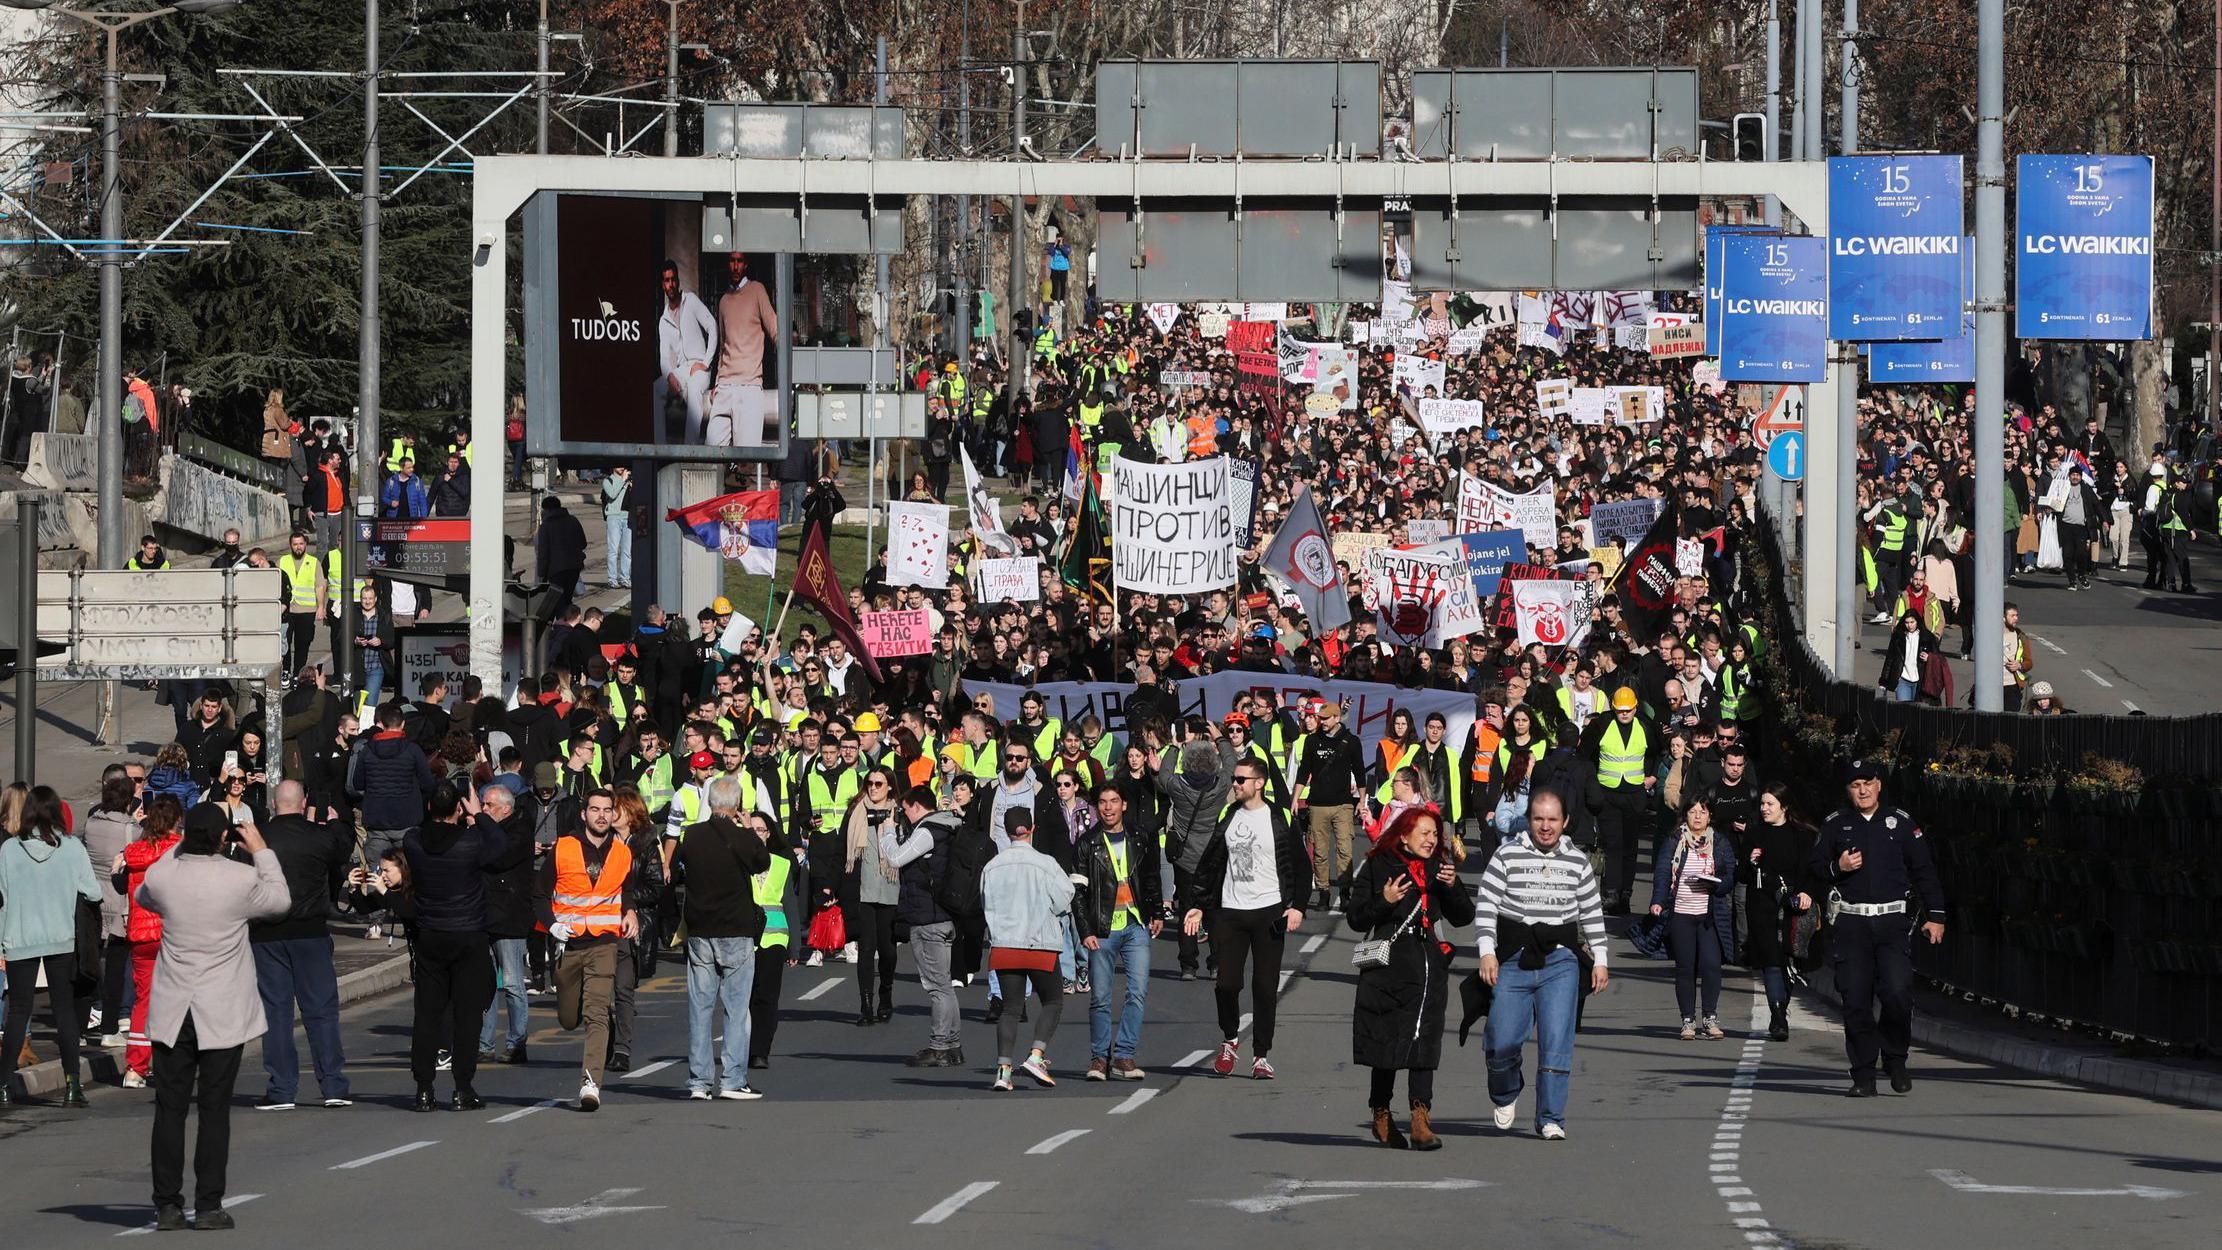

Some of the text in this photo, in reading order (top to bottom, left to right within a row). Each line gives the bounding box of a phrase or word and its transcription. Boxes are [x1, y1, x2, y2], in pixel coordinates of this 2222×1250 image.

[1882, 164, 1911, 193] 15
[2073, 164, 2103, 193] 15
[1384, 200, 1411, 211] PRA
[1836, 237, 1865, 256] LC
[2026, 235, 2056, 254] LC
[1765, 244, 1789, 266] 15
[1728, 299, 1751, 314] LC
[1852, 314, 1860, 325] 5
[1907, 313, 1922, 324] 61
[2040, 313, 2048, 323] 5
[2096, 313, 2110, 324] 61
[571, 318, 641, 342] TUDORS
[1664, 329, 1692, 340] НИСИ
[1738, 360, 1745, 369] 5
[1782, 360, 1793, 370] 61
[1887, 361, 1894, 370] 5
[1931, 361, 1943, 370] 61
[1461, 495, 1496, 523] НЕМА
[1515, 506, 1550, 517] ASPERA
[901, 514, 907, 526] 2
[1117, 504, 1232, 543] ПРОТИВ
[395, 552, 448, 563] 09:55:51
[1467, 549, 1495, 561] ojane
[1116, 542, 1235, 586] АШИНЕРИЈЕ
[993, 574, 1024, 588] ПРАВА
[866, 611, 923, 628] НЕЋЕТЕ
[881, 626, 912, 641] НАС
[867, 638, 928, 656] ГАЗИТИ
